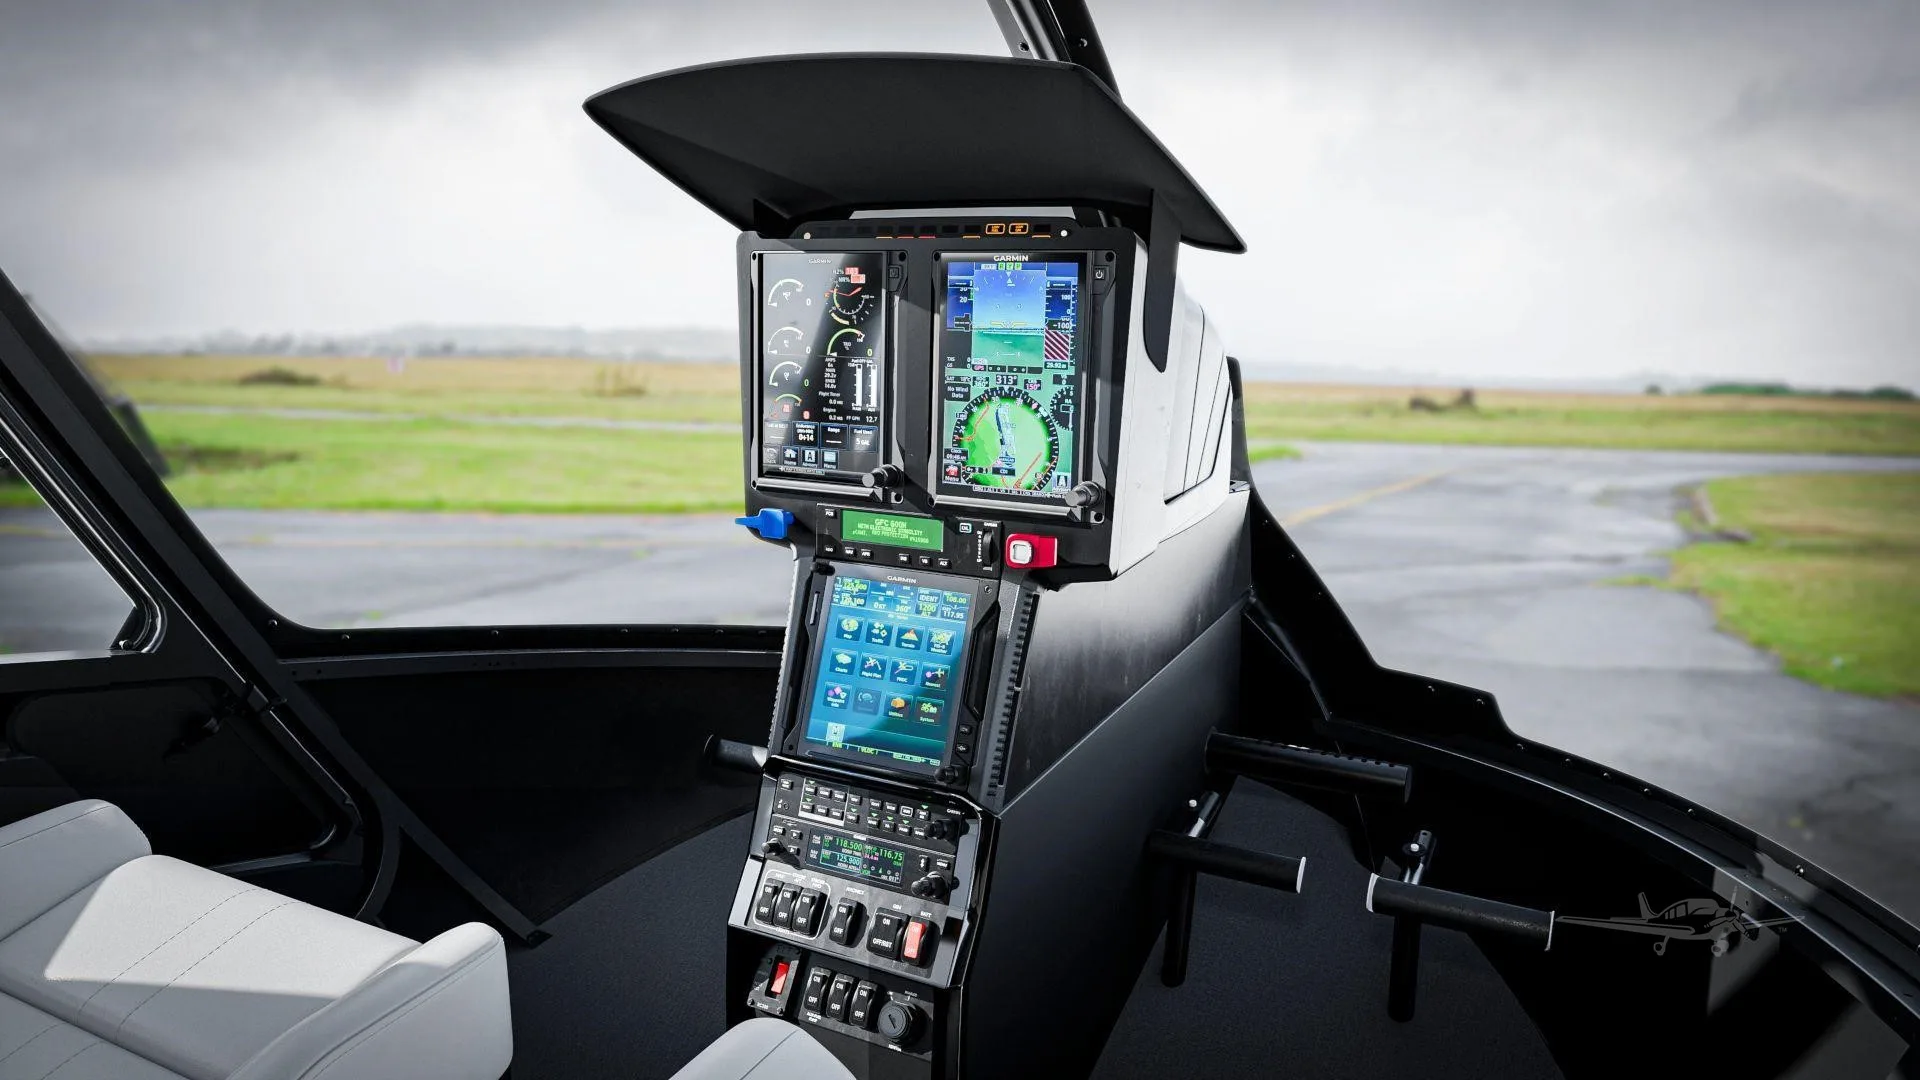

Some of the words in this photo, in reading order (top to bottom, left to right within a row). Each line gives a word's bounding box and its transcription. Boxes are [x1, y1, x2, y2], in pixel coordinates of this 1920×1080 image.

[806, 298, 811, 306] 0
[806, 346, 811, 354] 0
[996, 375, 1018, 385] 313°
[874, 519, 889, 527] GFC
[887, 575, 917, 584] GARMIN
[919, 594, 939, 602] IDENT
[919, 602, 937, 612] 1200
[836, 838, 862, 851] 118.500
[879, 848, 903, 861] 116.75
[836, 854, 860, 866] 125.900
[839, 906, 847, 914] ON
[873, 938, 893, 948] OFF/RST
[831, 1003, 841, 1011] OFF
[854, 1010, 864, 1018] OFF
